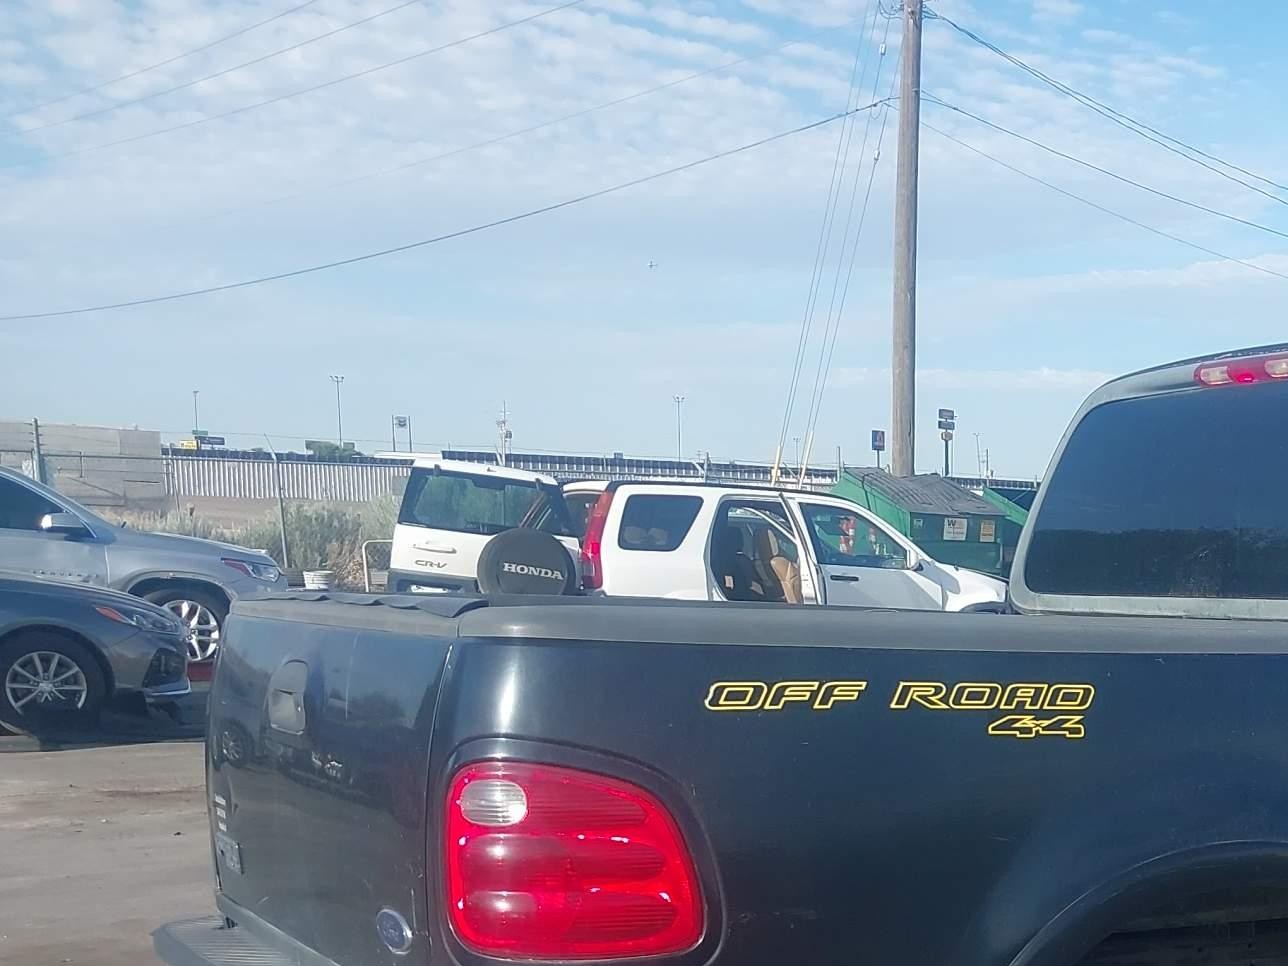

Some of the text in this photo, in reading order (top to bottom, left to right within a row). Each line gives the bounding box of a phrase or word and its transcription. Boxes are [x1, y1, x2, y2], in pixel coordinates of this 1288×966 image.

[415, 559, 448, 569] CR-V
[503, 562, 564, 580] HONDA
[704, 681, 1096, 711] OFF ROAD
